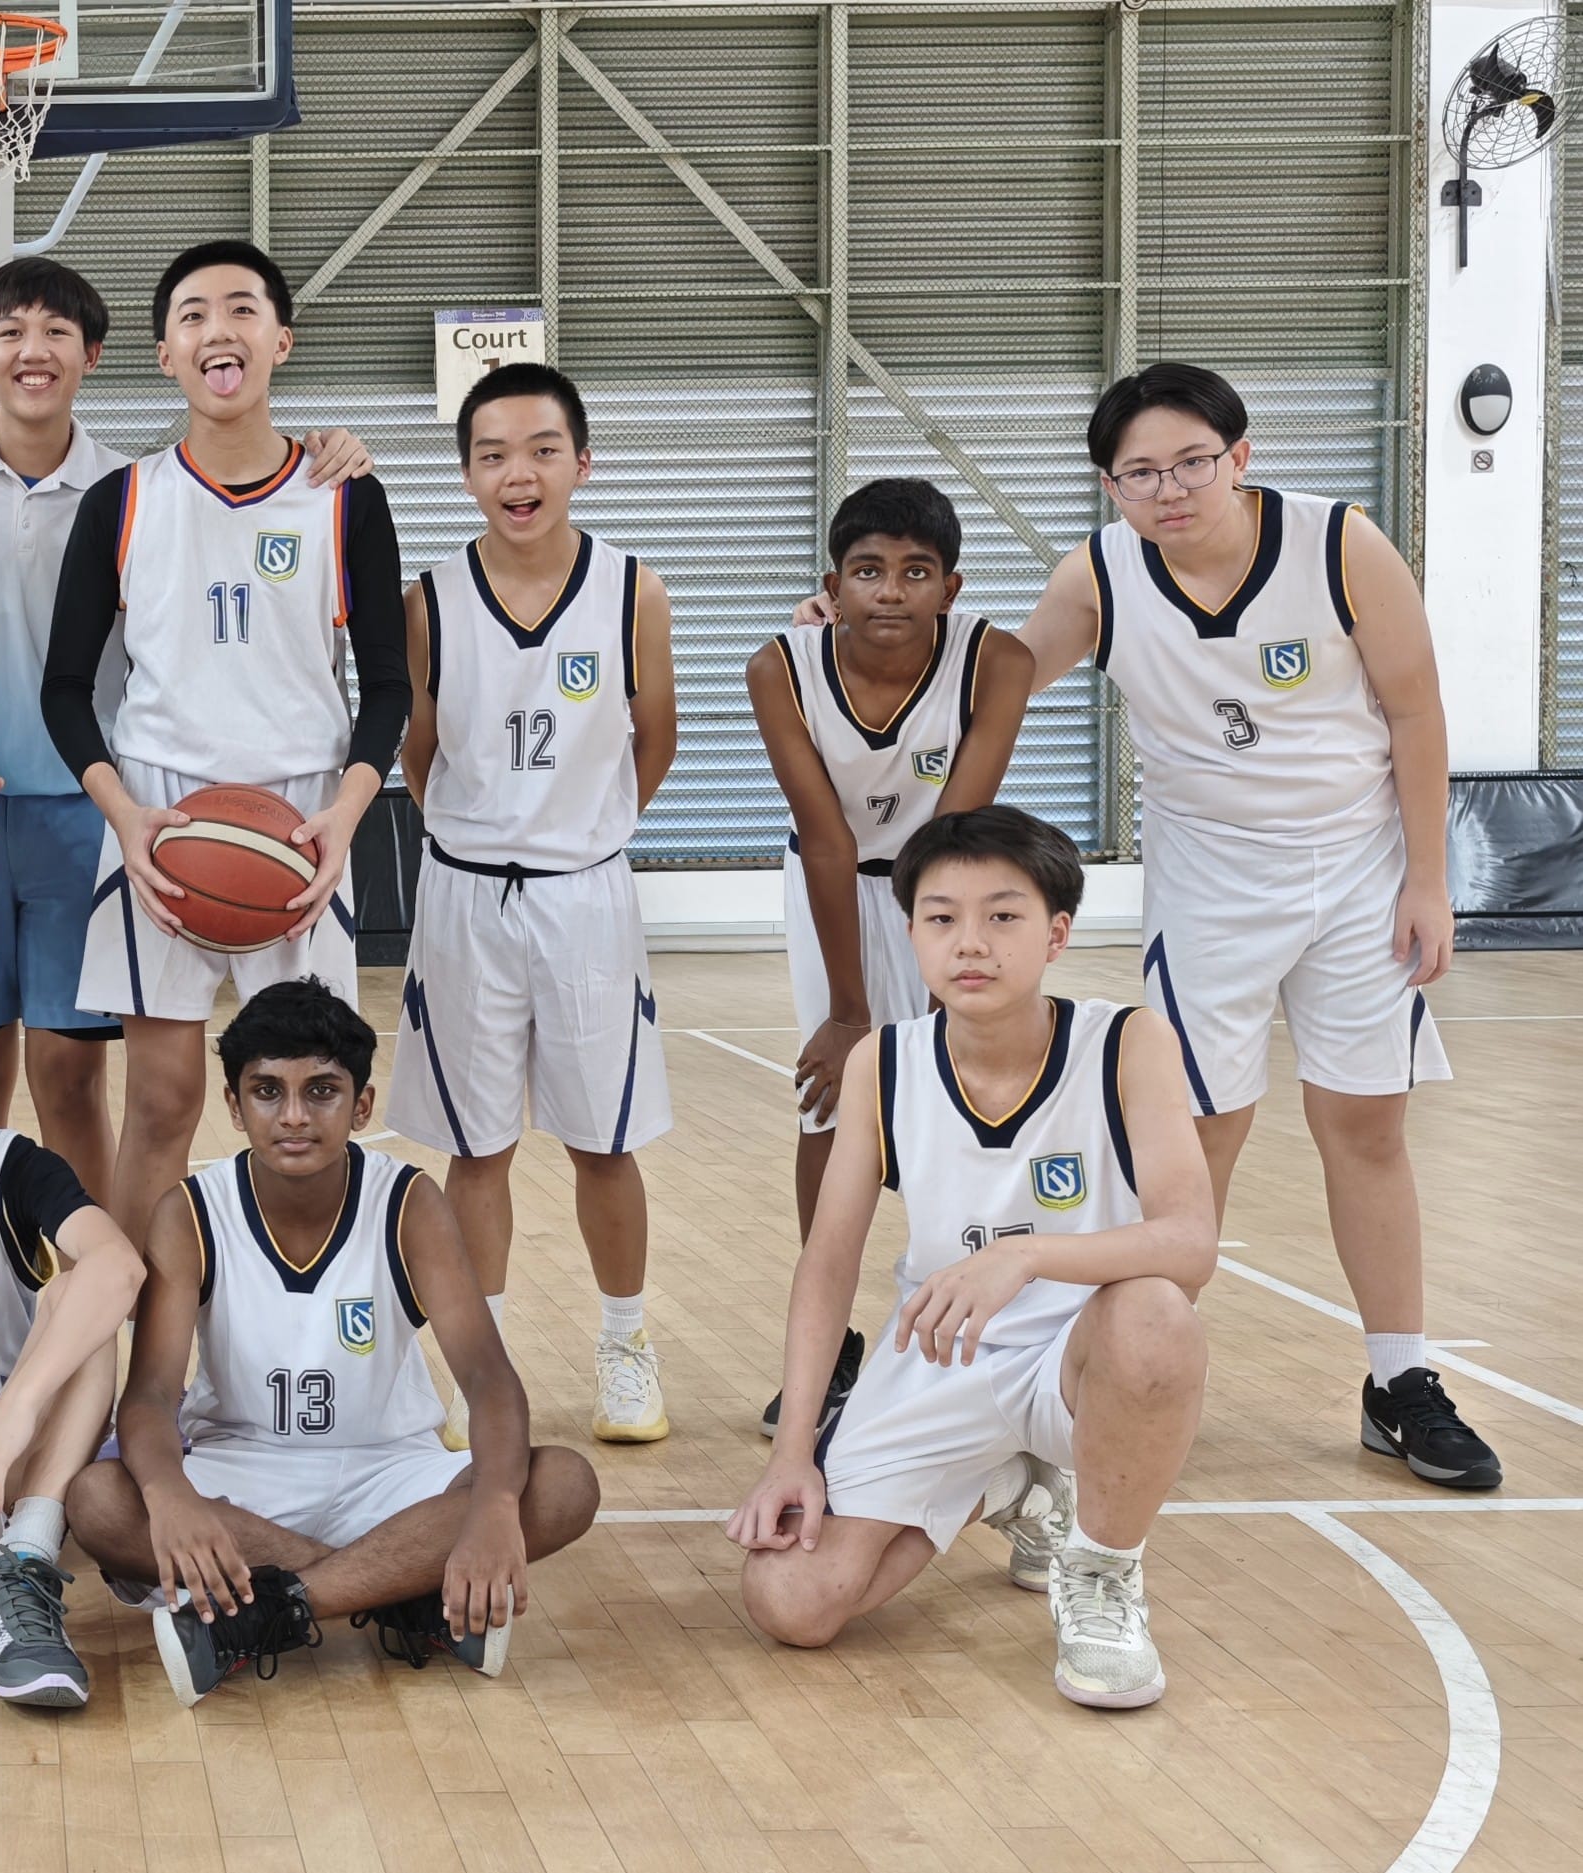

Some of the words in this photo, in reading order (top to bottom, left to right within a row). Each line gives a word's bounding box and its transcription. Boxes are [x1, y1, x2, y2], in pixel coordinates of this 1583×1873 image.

[452, 328, 528, 350] Court
[207, 581, 250, 644] 11
[505, 709, 556, 771] 12
[1213, 698, 1260, 751] 3
[866, 793, 901, 826] 7
[266, 1368, 335, 1436] 13
